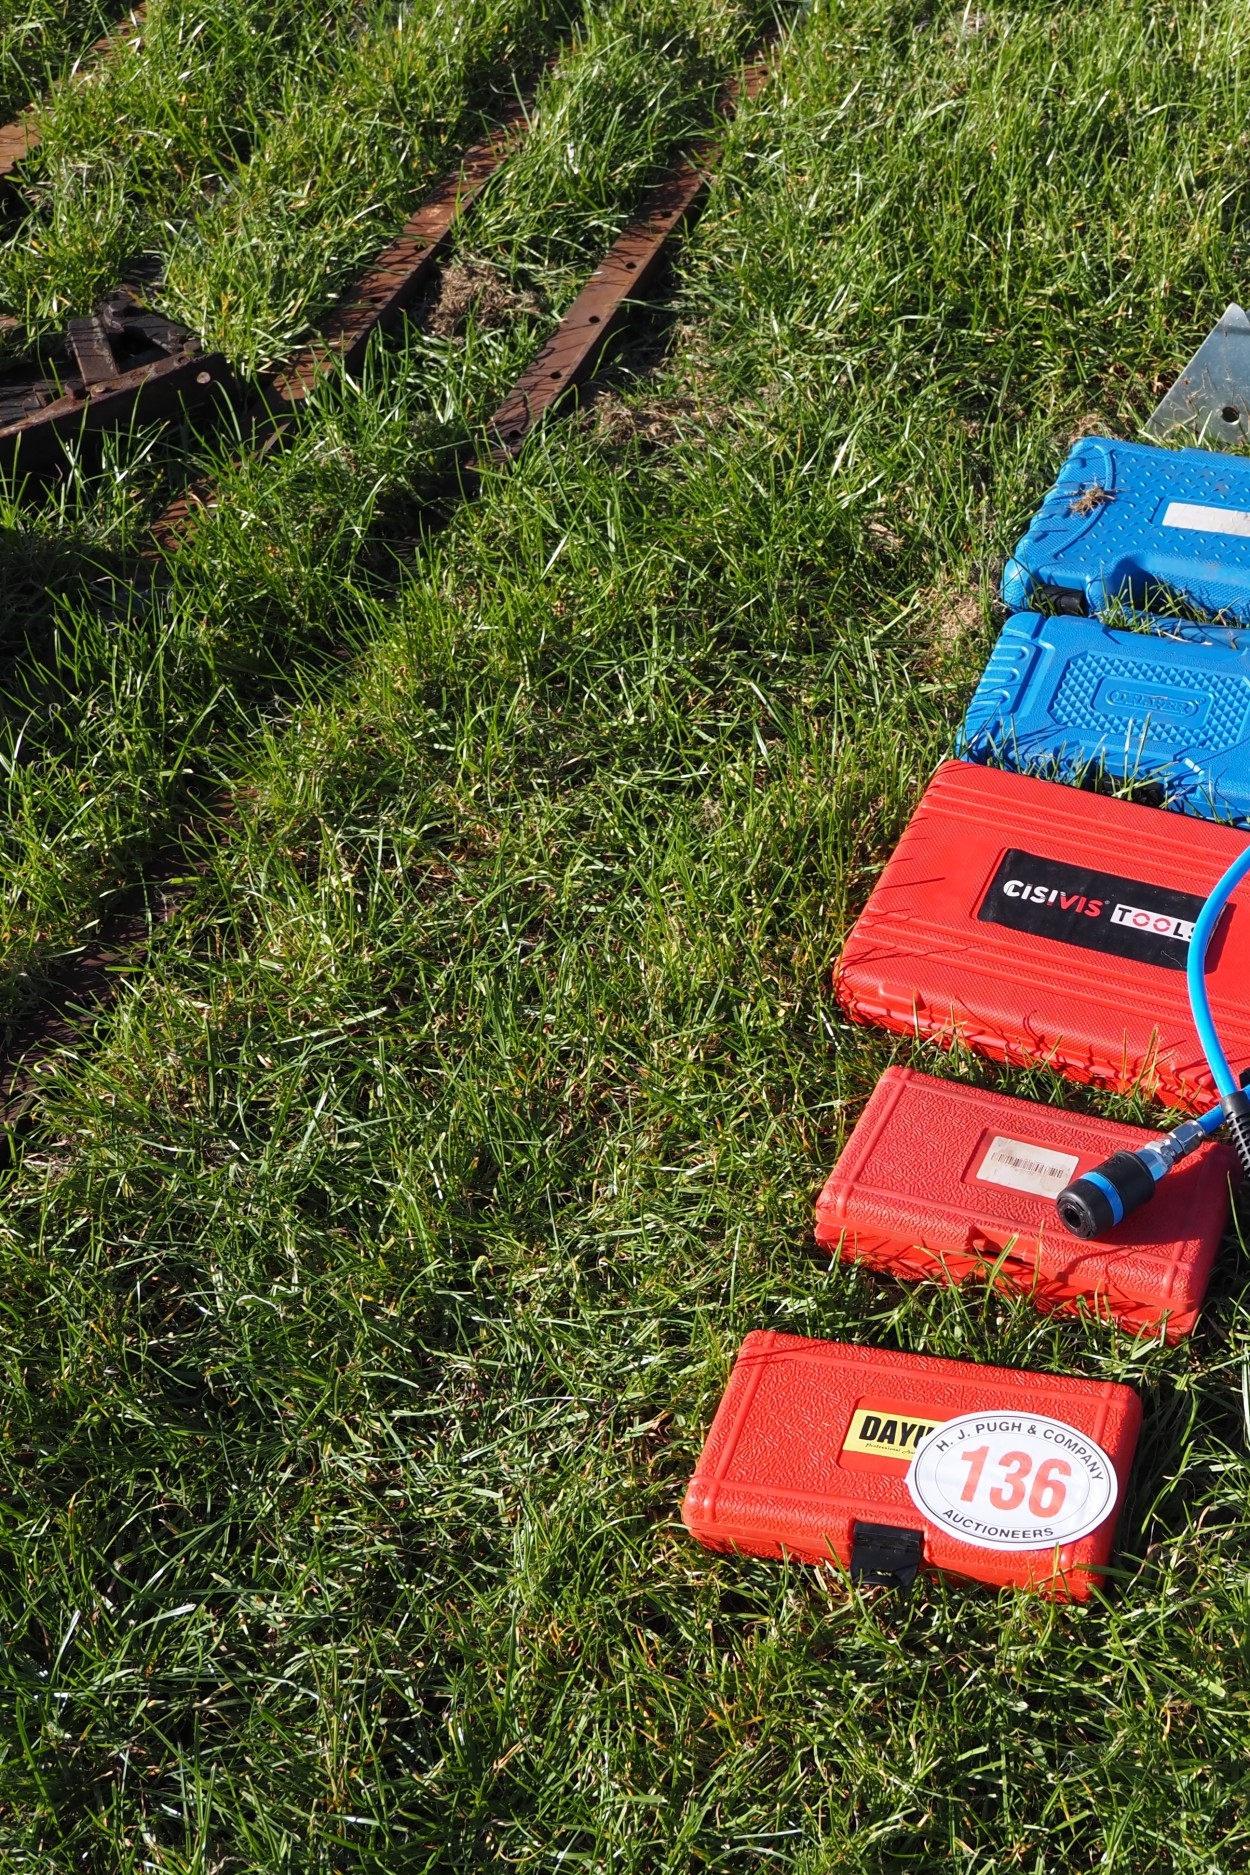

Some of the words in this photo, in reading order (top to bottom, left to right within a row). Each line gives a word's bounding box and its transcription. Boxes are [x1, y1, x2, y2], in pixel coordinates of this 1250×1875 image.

[1003, 880, 1104, 917] CISIVIS
[936, 1440, 953, 1452] H.
[957, 1428, 970, 1440] J.
[975, 1421, 1022, 1435] PUGH
[1027, 1424, 1039, 1435] &
[1043, 1428, 1104, 1481] COMPANY
[959, 1445, 1072, 1519] 136
[942, 1508, 1054, 1539] AUCTIONEERS
